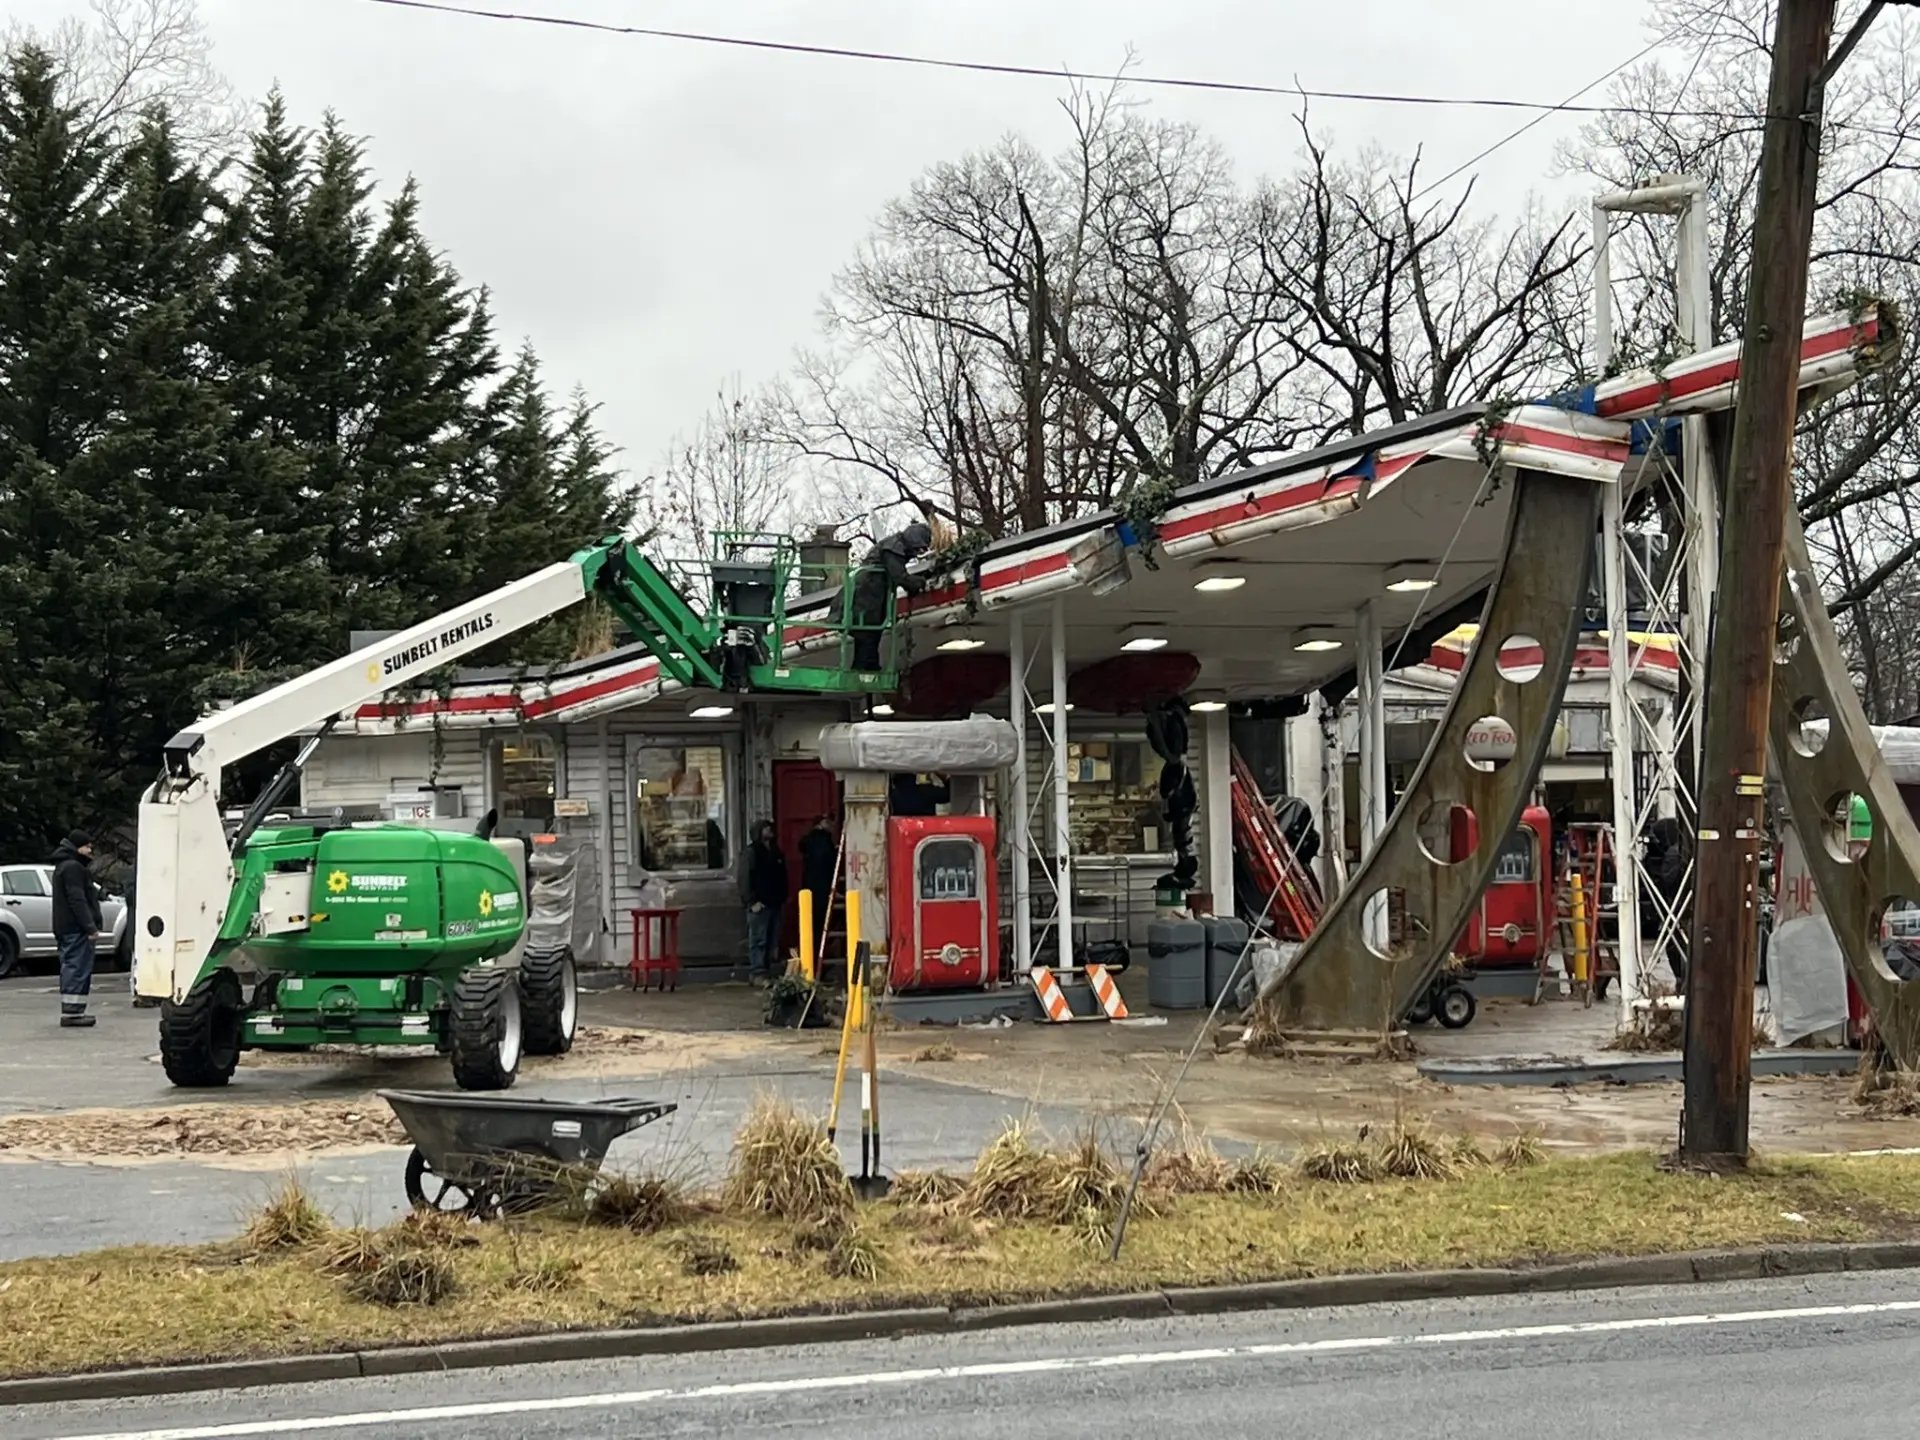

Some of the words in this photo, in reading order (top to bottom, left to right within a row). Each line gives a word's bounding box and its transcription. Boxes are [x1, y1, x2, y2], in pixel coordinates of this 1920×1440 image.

[383, 636, 438, 675] SUNBELT
[440, 612, 494, 649] RENTALS
[412, 805, 432, 819] ICE
